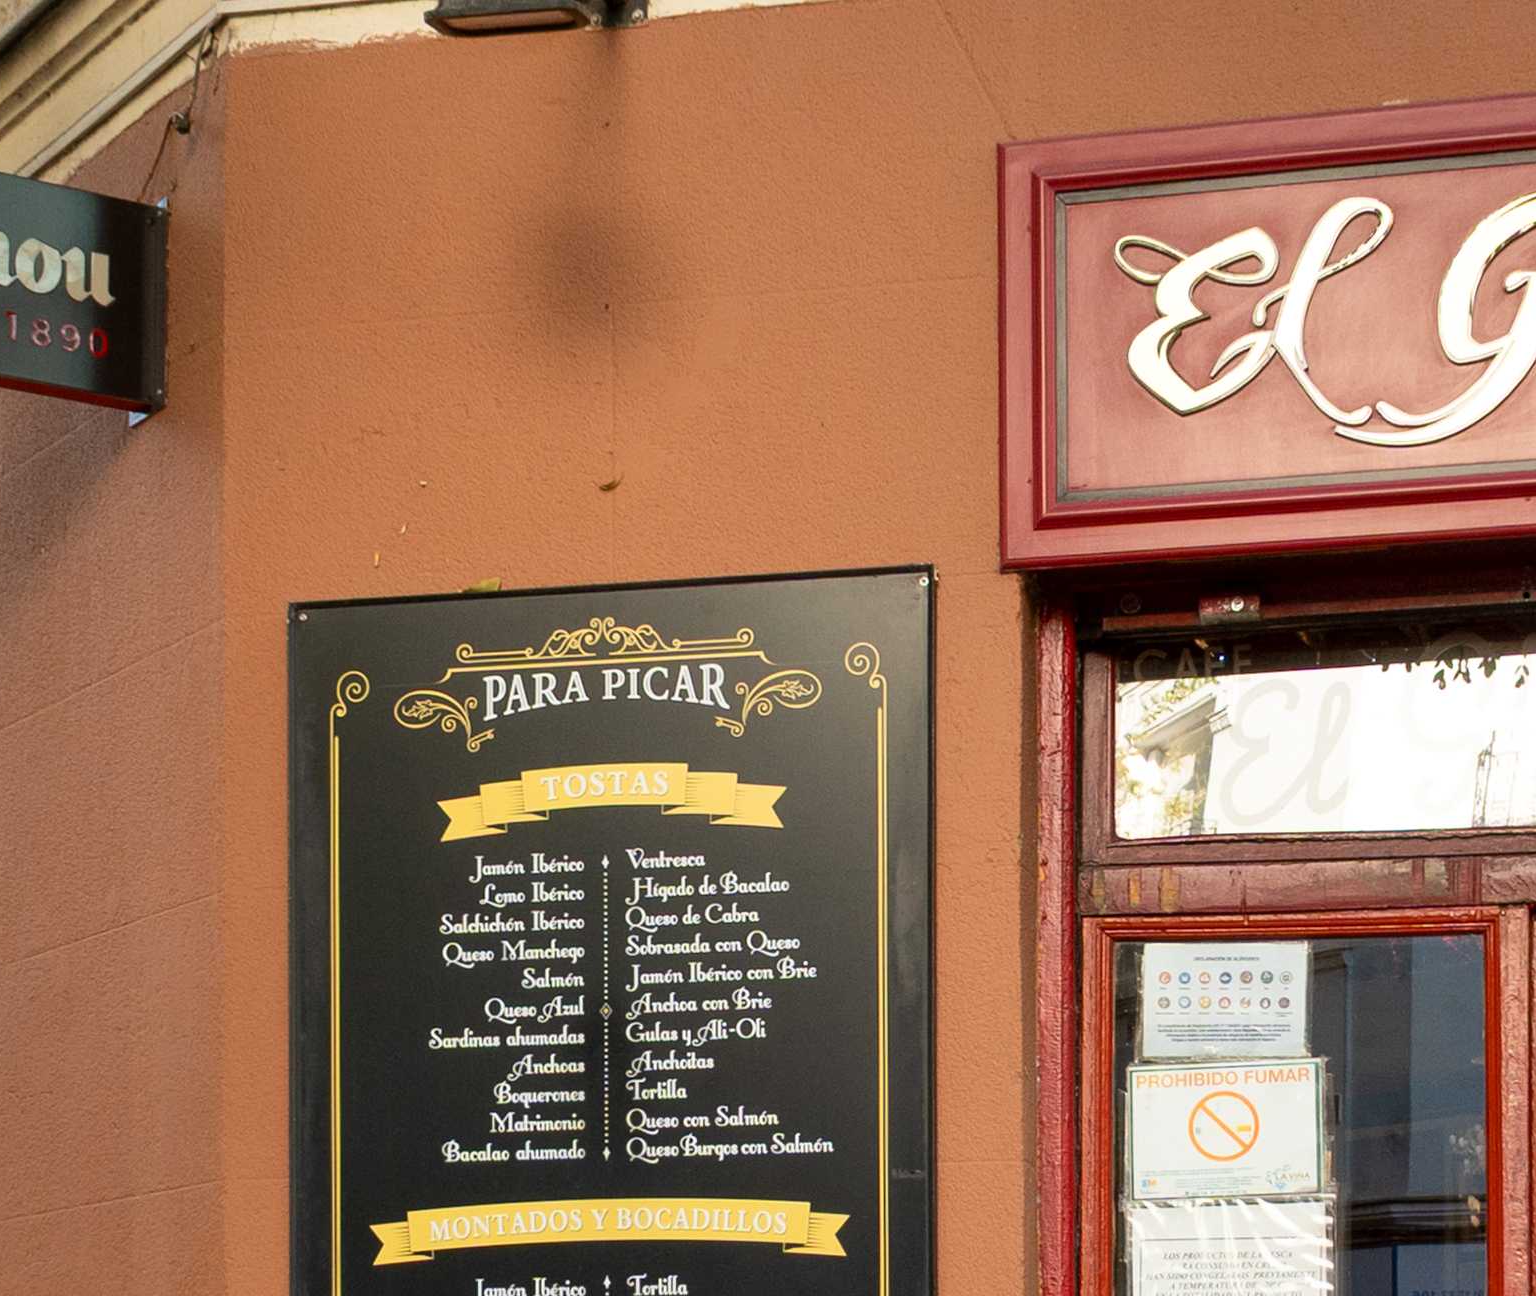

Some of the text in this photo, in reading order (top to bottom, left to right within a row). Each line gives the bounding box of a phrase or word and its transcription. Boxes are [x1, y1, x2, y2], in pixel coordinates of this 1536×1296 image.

[1113, 196, 1395, 425] El
[5, 310, 110, 359] 1890
[483, 663, 730, 721] PARA PICAR
[541, 772, 668, 800] TOSTAS
[469, 853, 584, 883] Jamón Ibérico
[625, 871, 790, 905] Hígado de Bacalao
[521, 968, 584, 989] Salmón
[429, 1024, 585, 1049] Sardinas ahumadas
[626, 1018, 766, 1046] Gulas y Ali-Oli
[626, 1078, 687, 1100] Tortilla
[1135, 1066, 1311, 1091] PROHIBIDO FUMAR
[490, 1112, 585, 1133] Matrimonio
[626, 1133, 834, 1164] Queso Burgos con Salmón
[432, 1209, 785, 1239] MONTADOS Y BOCADILLOS
